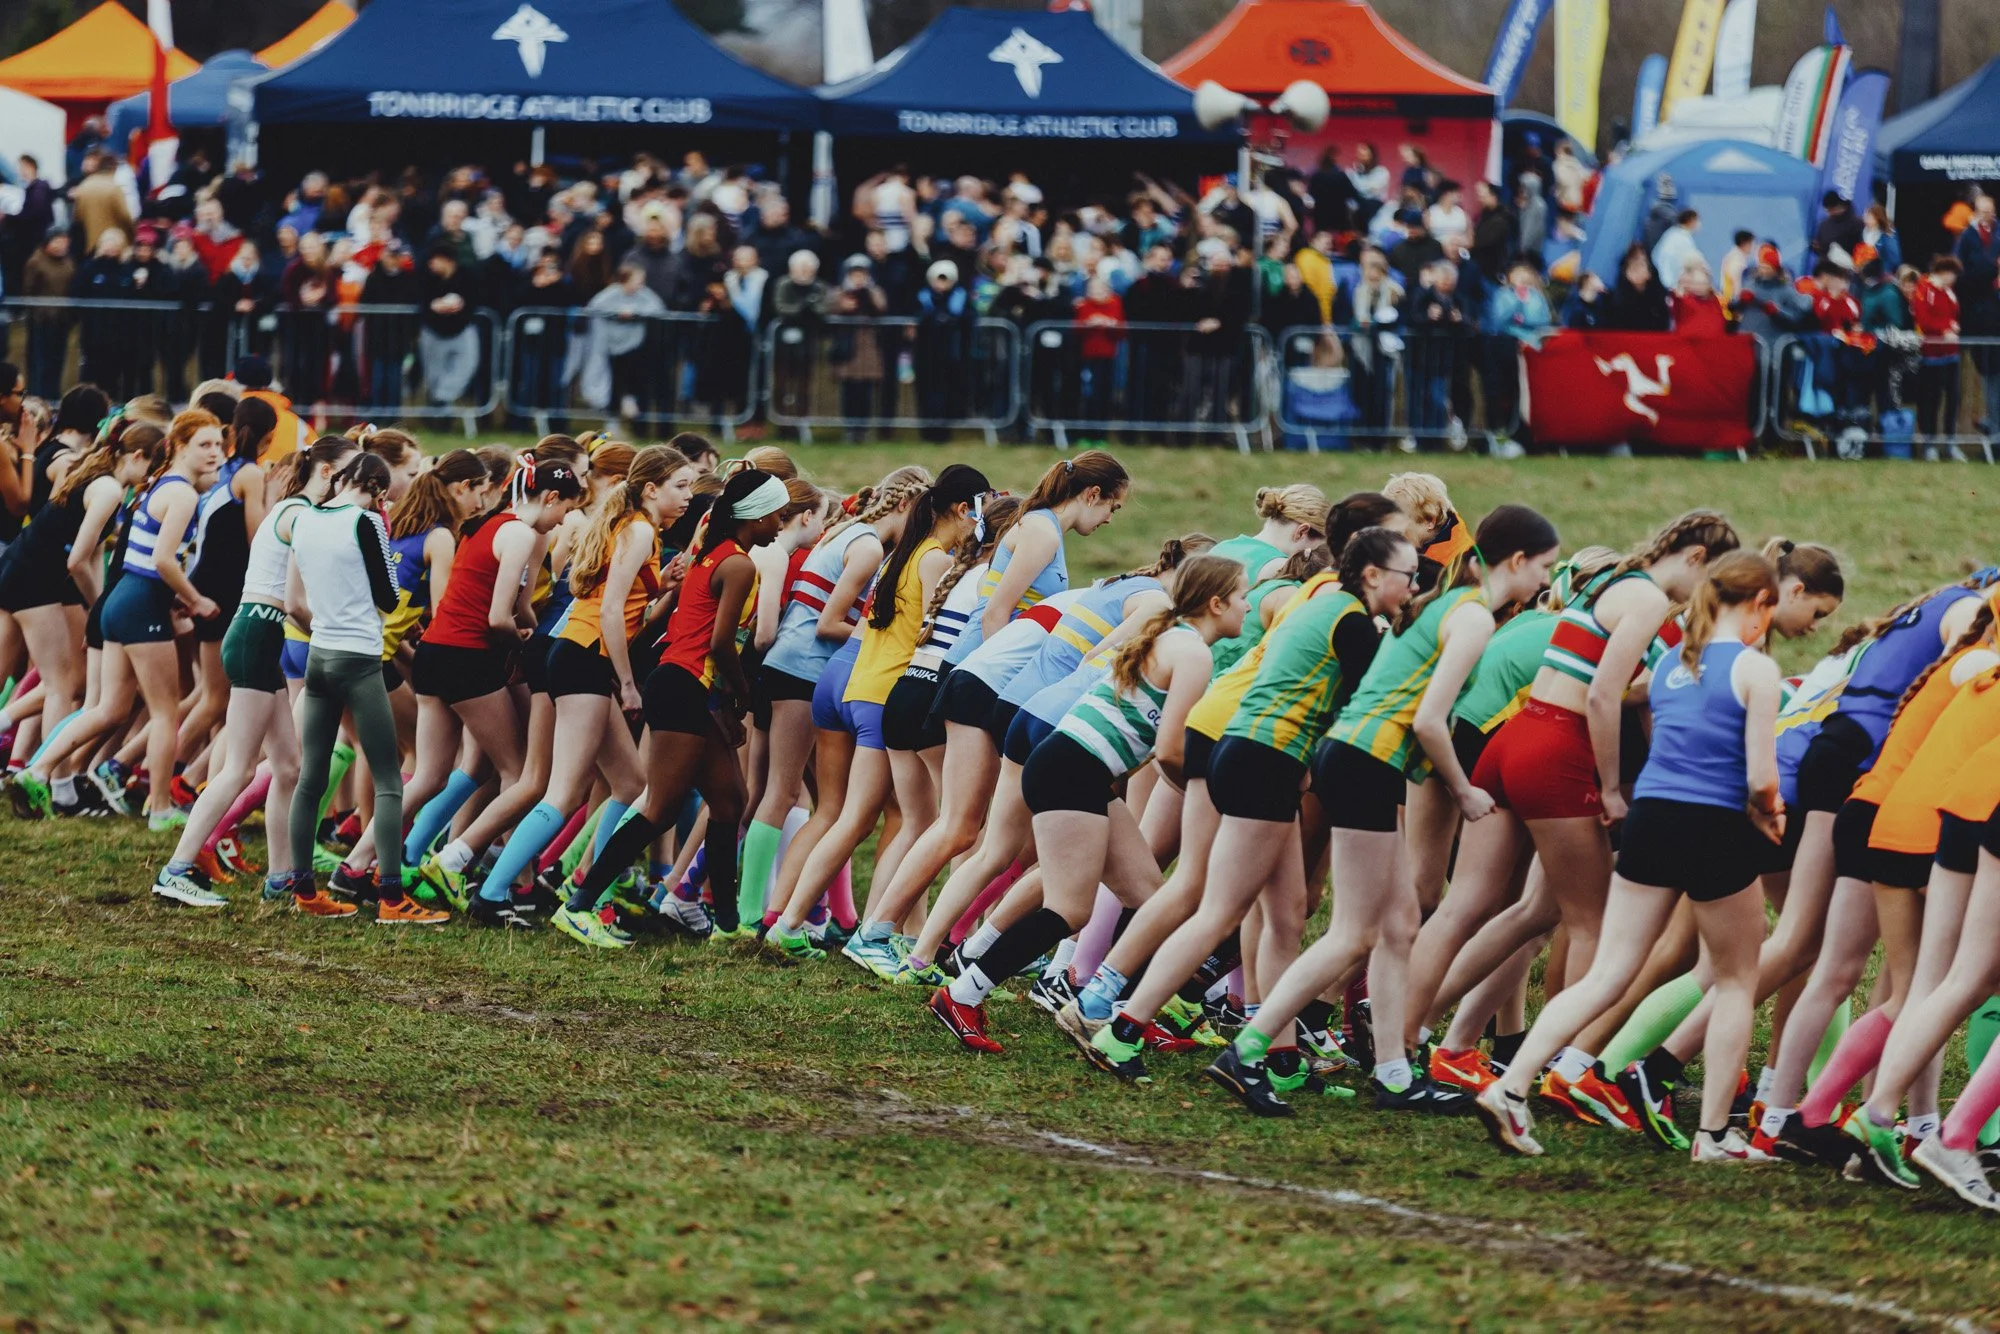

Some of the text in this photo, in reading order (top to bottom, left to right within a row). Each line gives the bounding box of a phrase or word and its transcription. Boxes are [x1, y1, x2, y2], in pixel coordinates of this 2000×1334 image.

[367, 91, 713, 124] TONBRIDGE ATHLETIC CLUB
[898, 110, 1179, 138] TONBRIDGE ATHLETIC CLUB
[247, 604, 285, 623] NIK
